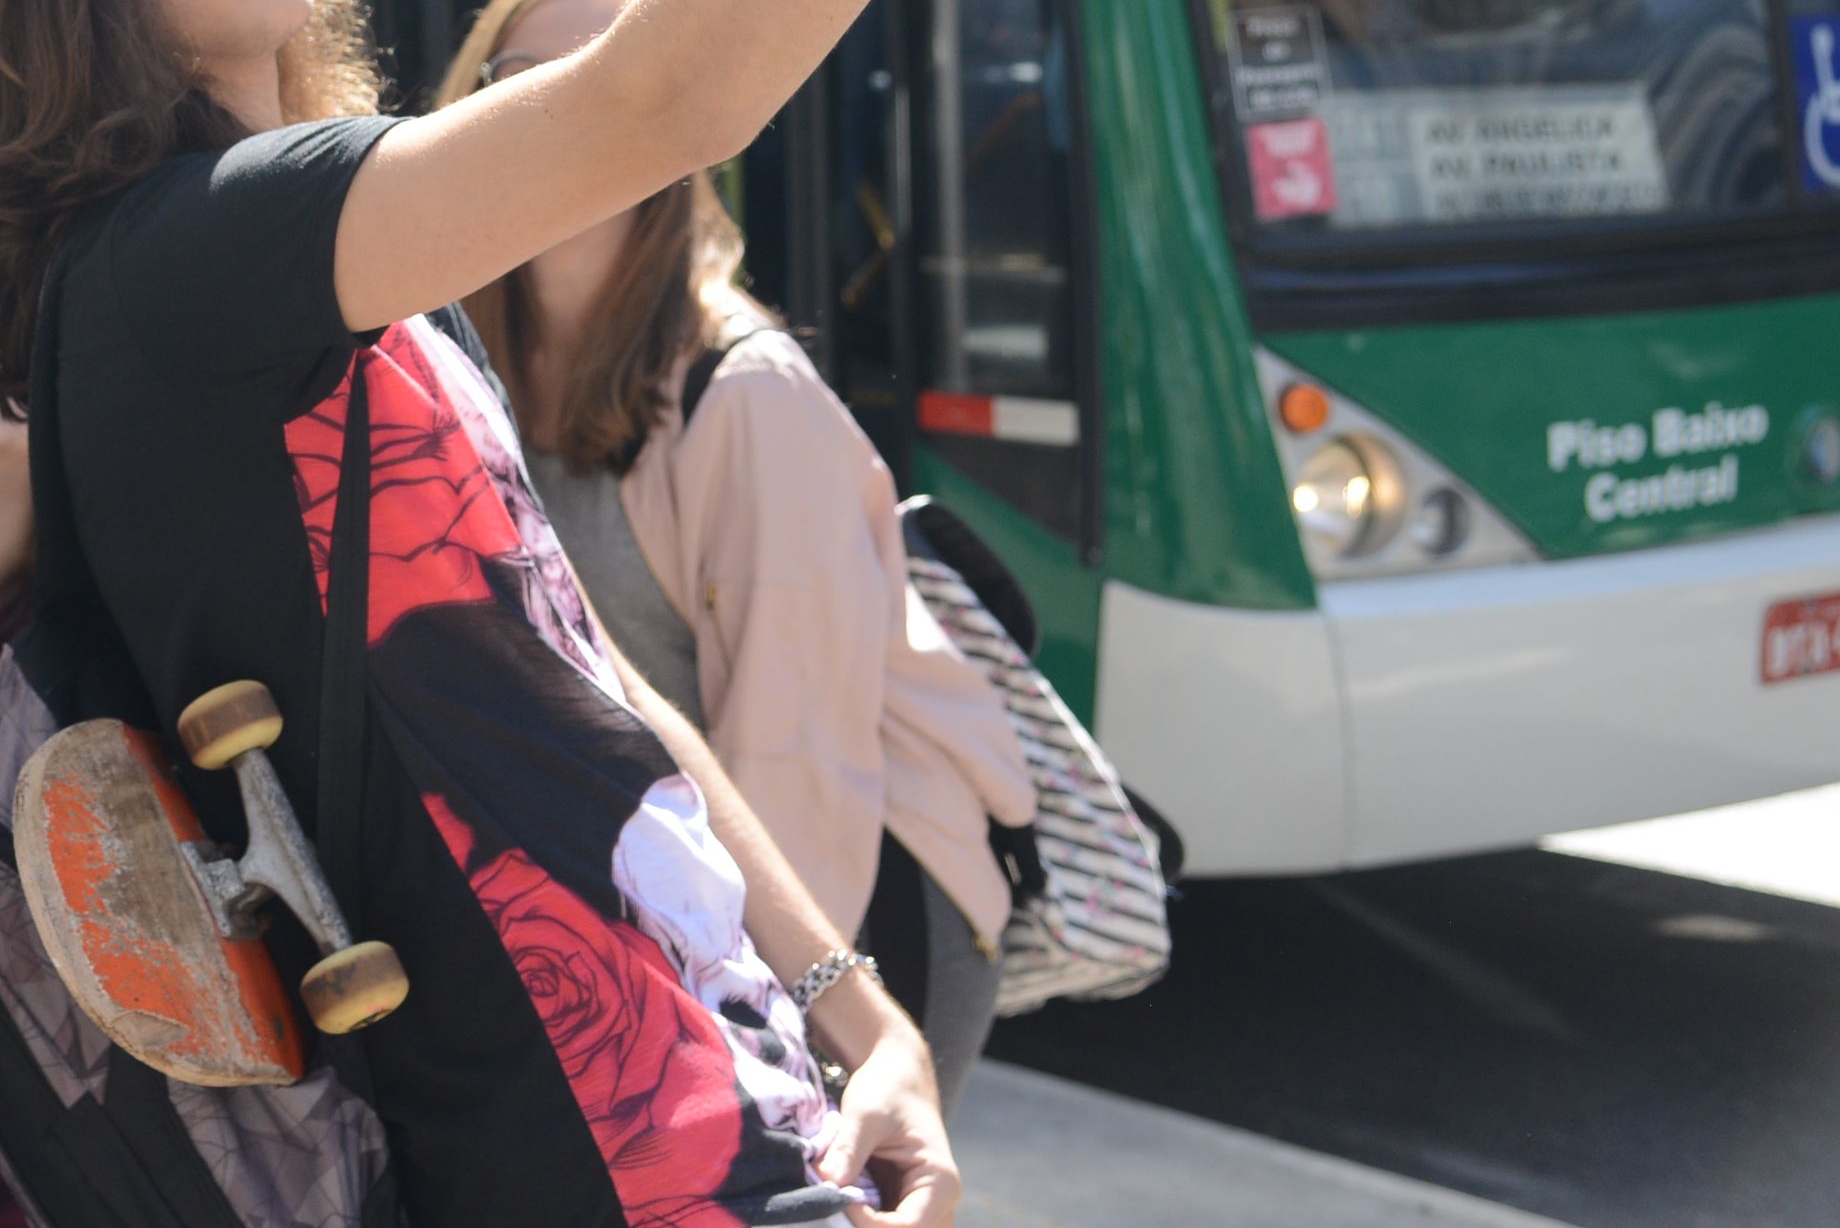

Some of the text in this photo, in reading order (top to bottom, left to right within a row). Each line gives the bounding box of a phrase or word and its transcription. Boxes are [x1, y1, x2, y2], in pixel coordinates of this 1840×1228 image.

[1547, 400, 1770, 473] Piso Baixo
[1584, 453, 1739, 522] Central
